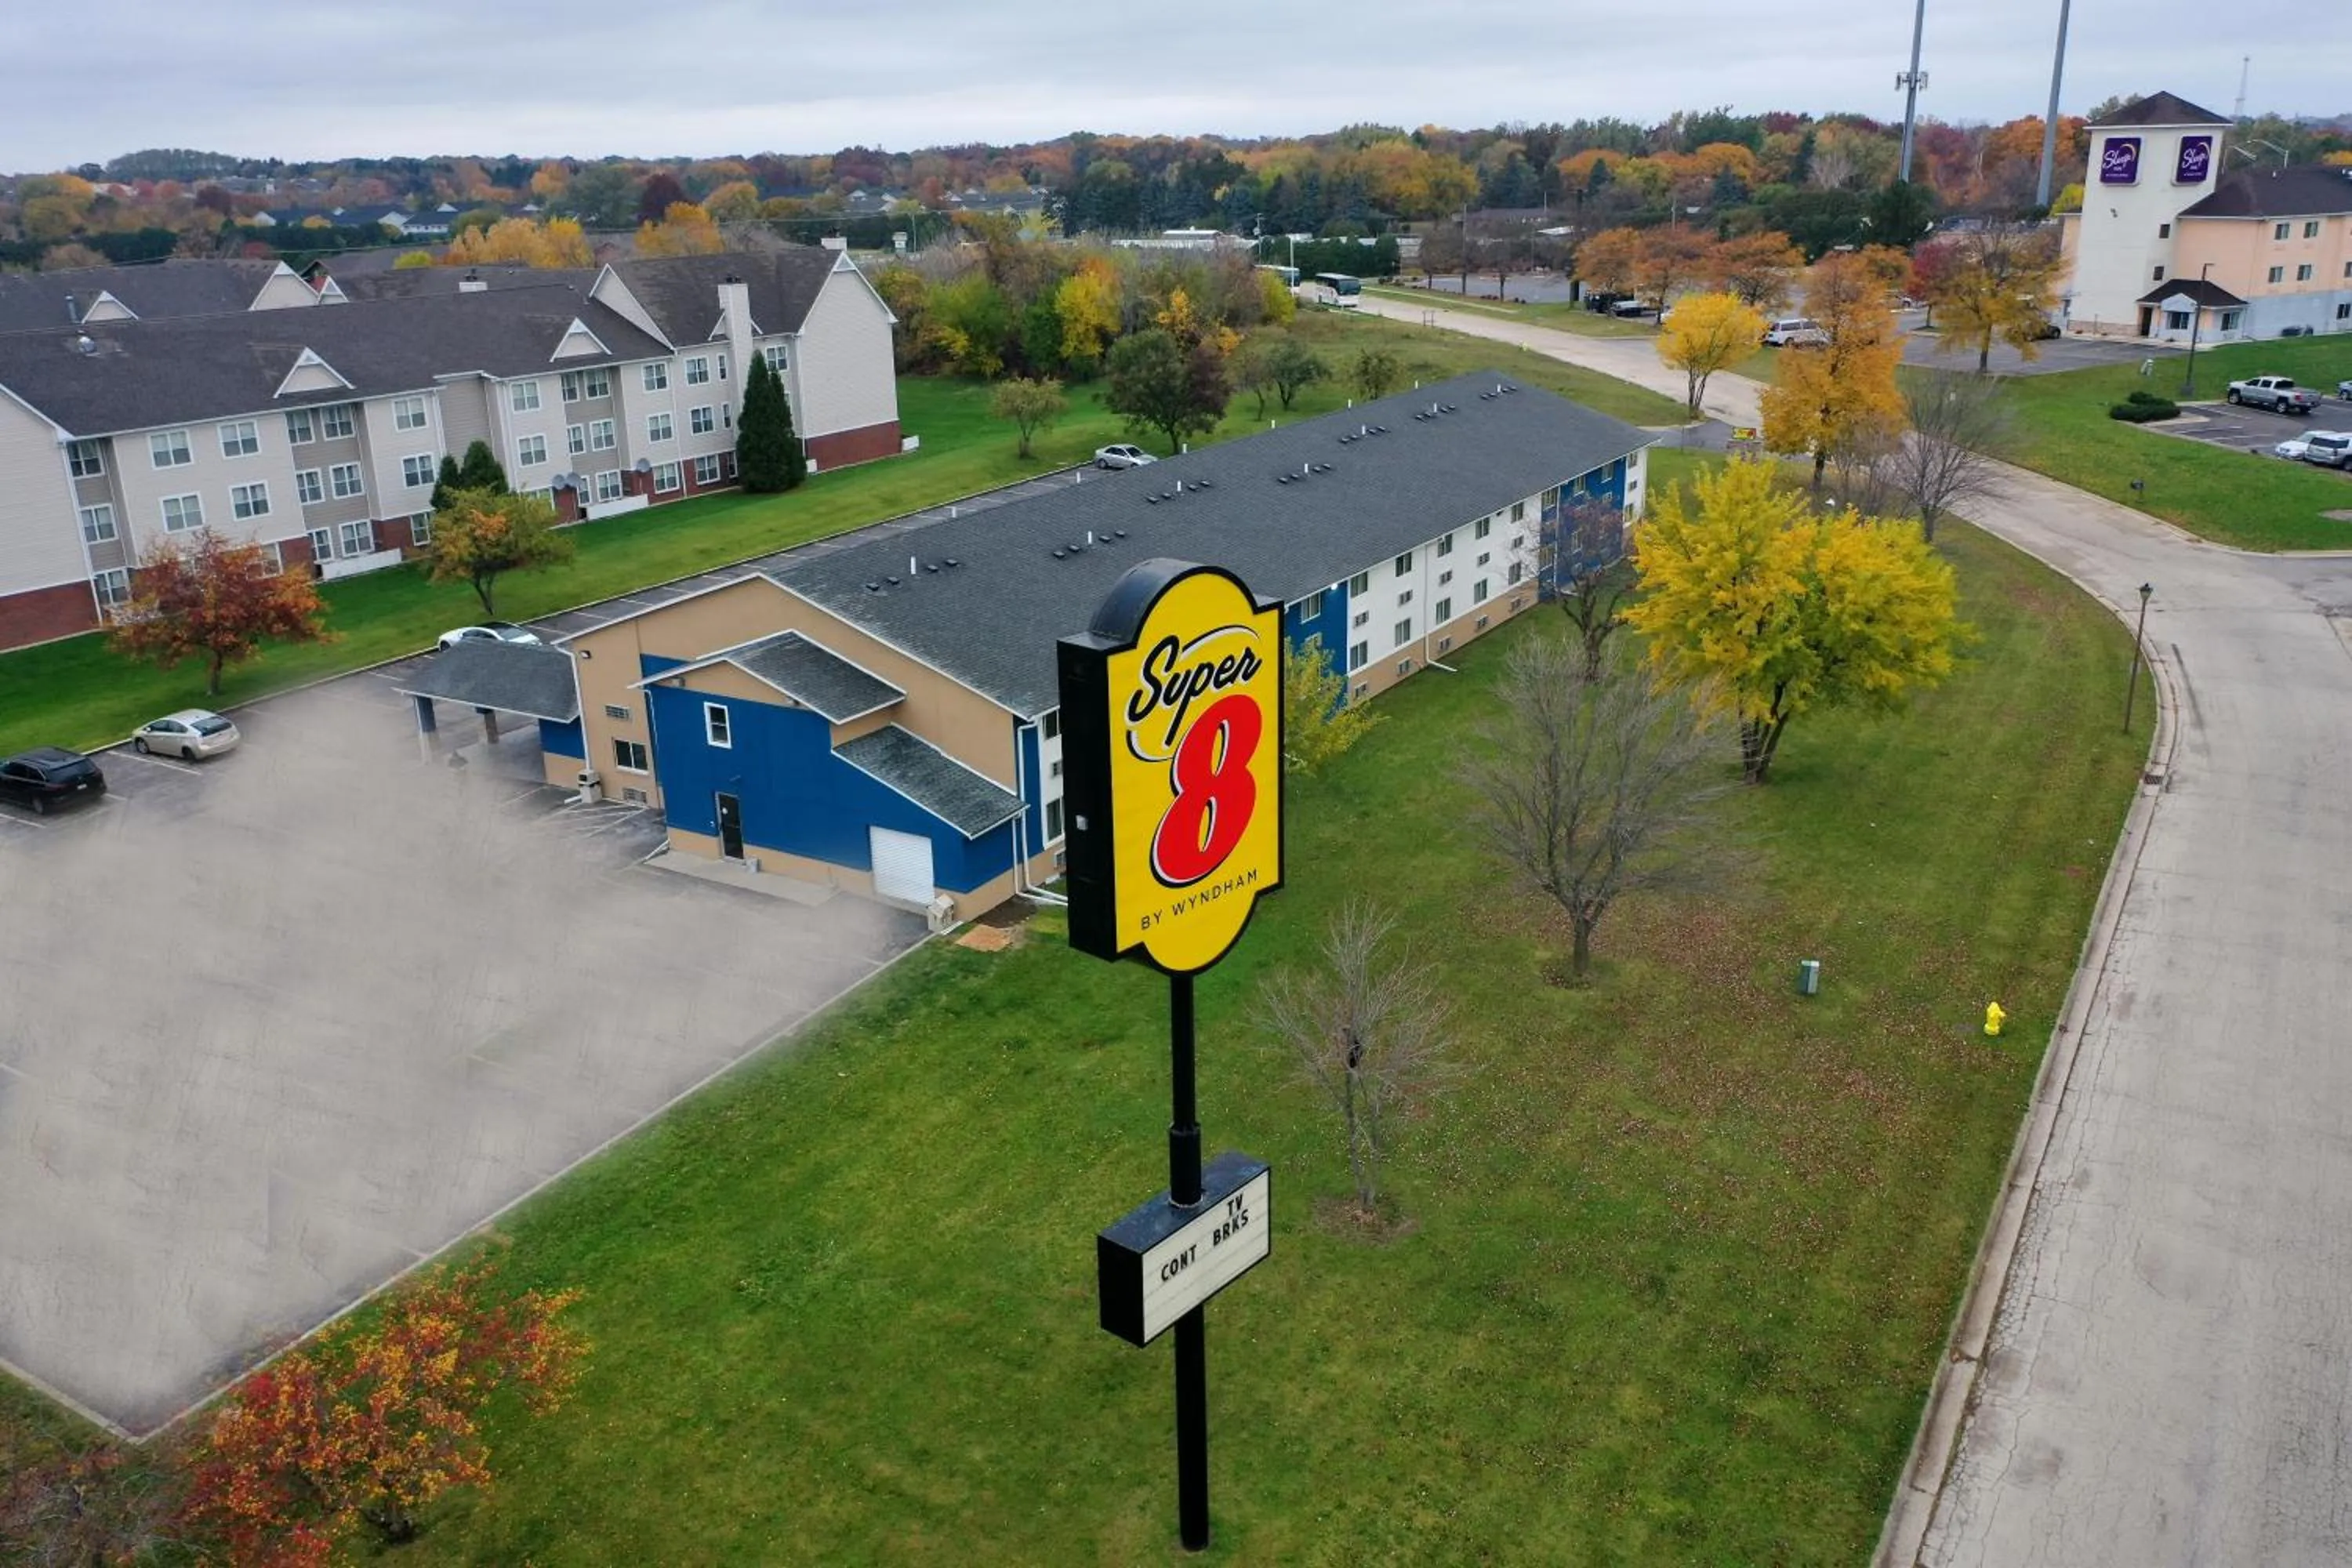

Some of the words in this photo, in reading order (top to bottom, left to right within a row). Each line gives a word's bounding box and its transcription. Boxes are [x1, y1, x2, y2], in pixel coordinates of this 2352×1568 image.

[1127, 633, 1263, 747] Super
[1149, 694, 1263, 888] 8
[1141, 909, 1163, 931] BY
[1172, 868, 1258, 916] WYNDHAM
[1227, 1193, 1243, 1217] TV
[1160, 1244, 1197, 1283] CONT
[1213, 1208, 1249, 1247] BRKS
